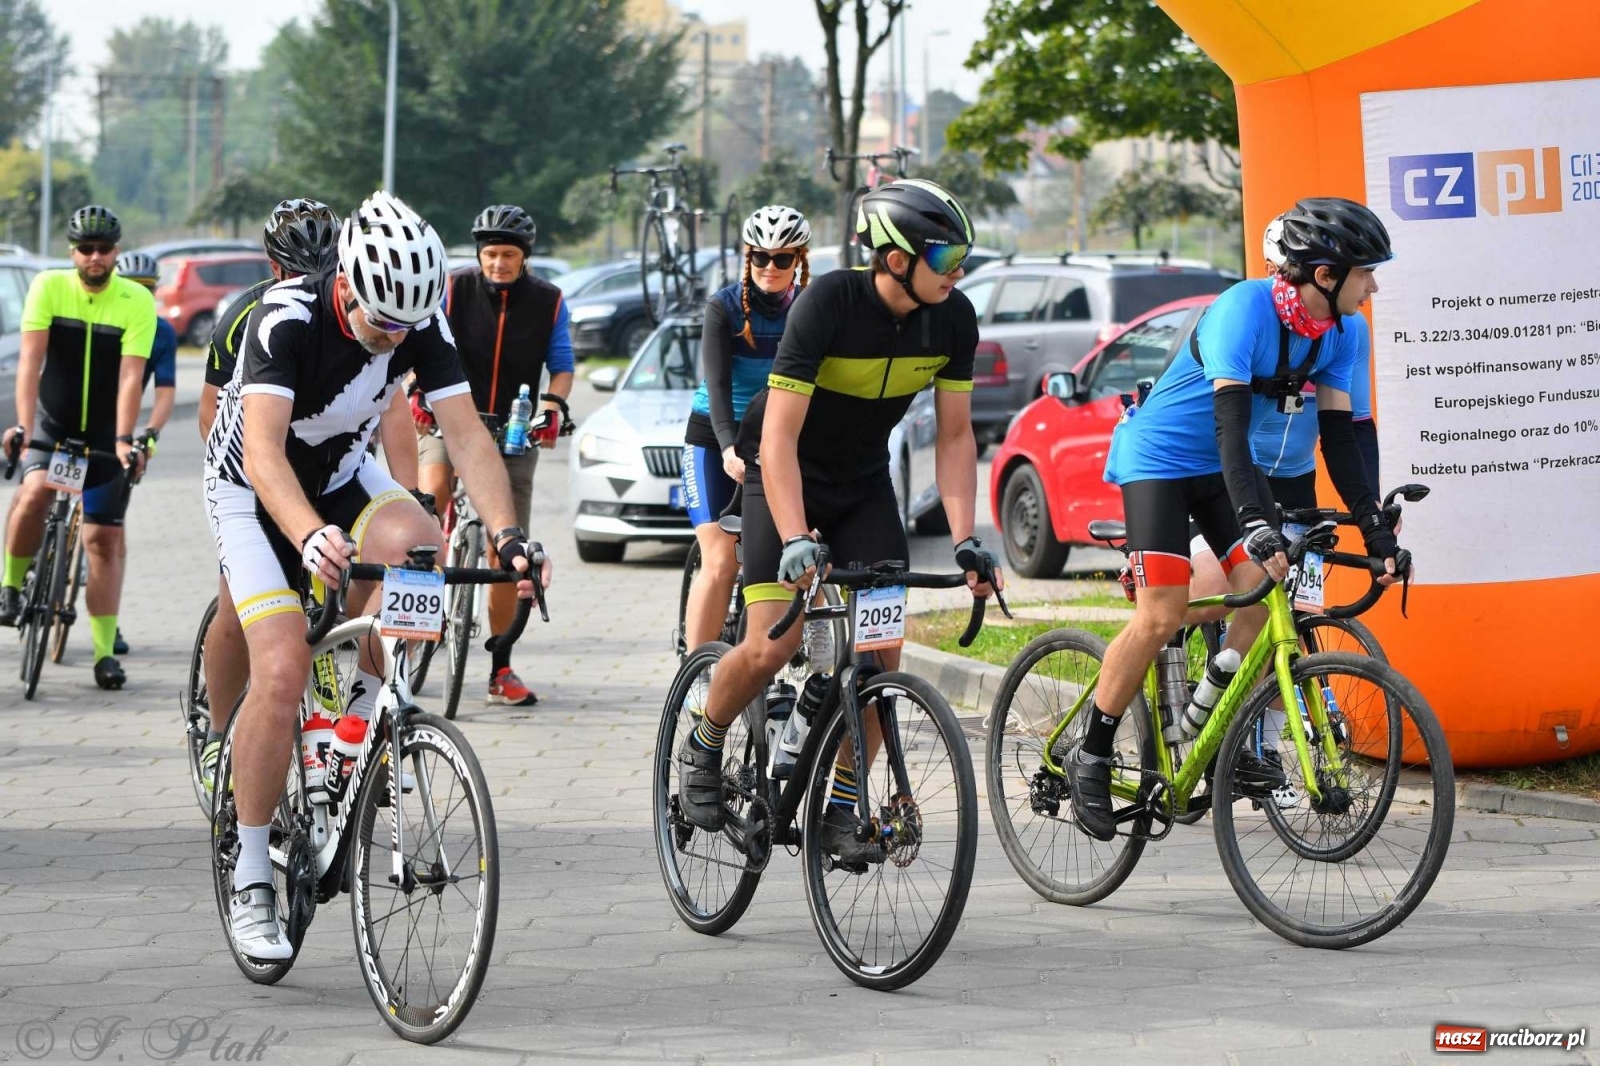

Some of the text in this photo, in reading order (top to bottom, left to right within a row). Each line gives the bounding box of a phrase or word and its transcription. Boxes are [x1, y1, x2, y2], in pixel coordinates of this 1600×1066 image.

[1431, 287, 1600, 311] Projekt o numerze rejestr
[1394, 319, 1600, 343] PL. 3.22/3.304/09.01281 pn: “Bi
[1406, 364, 1432, 379] jest
[1434, 357, 1563, 378] współfinansowany
[1566, 357, 1577, 367] w
[1434, 388, 1600, 410] Europejskiego Funduszu
[1420, 419, 1599, 444] Regionalnego oraz do 10%
[1411, 462, 1467, 475] budżetu
[1471, 460, 1529, 476] państwa
[1299, 570, 1322, 591] 094
[387, 591, 441, 615] 2089
[859, 604, 903, 628] 2092
